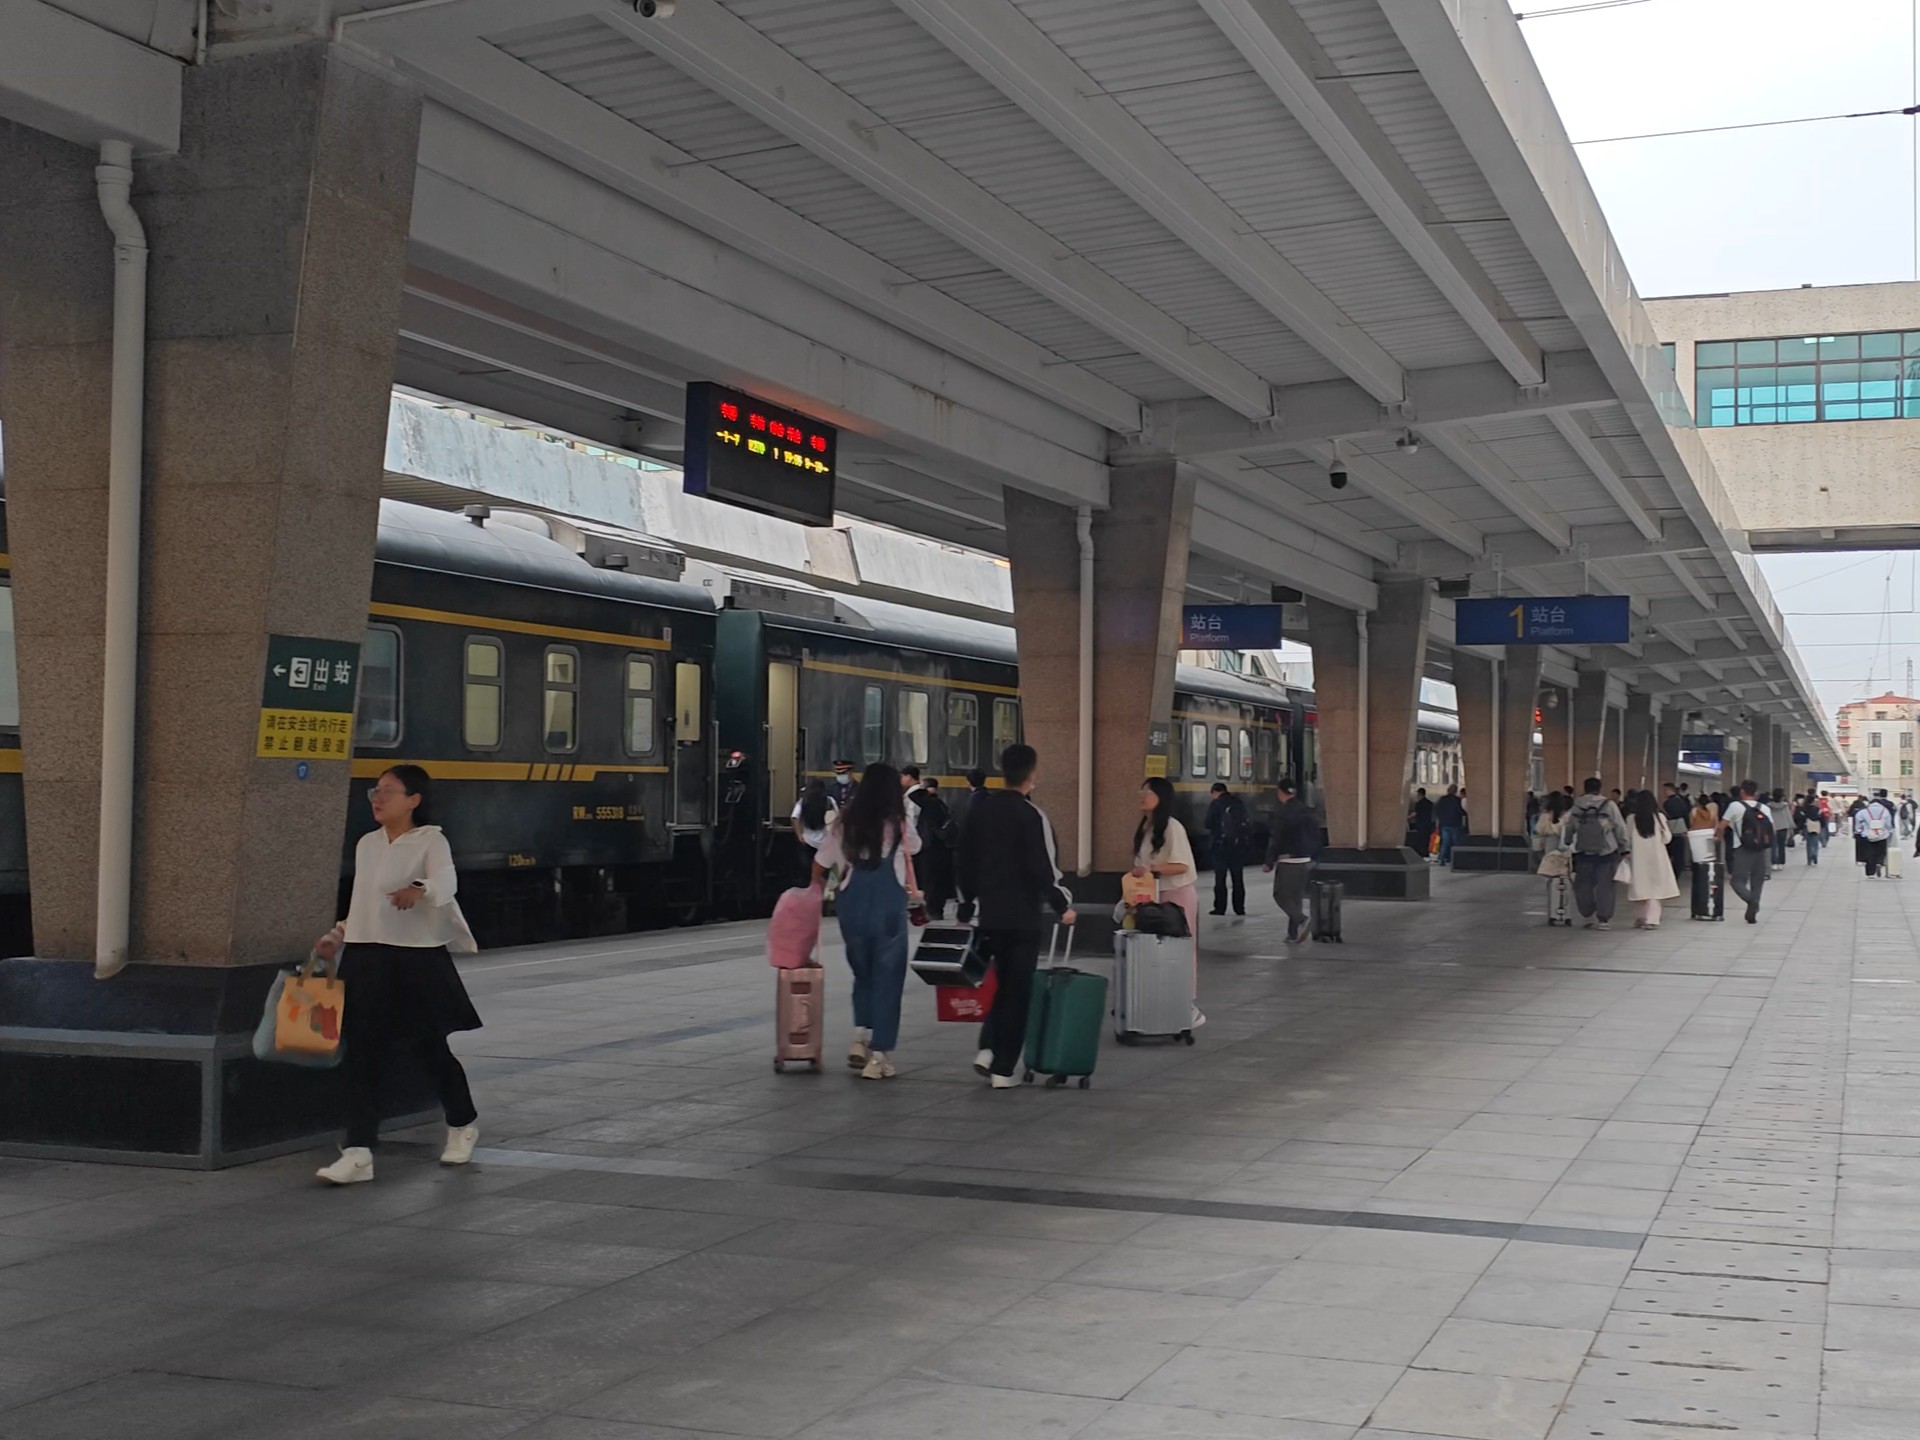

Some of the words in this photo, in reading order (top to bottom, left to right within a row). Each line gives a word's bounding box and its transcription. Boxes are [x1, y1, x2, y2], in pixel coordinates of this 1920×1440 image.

[1190, 613, 1224, 631] 站台
[1508, 604, 1524, 639] 1
[1530, 605, 1567, 624] 站台
[1189, 632, 1230, 643] Platform
[1530, 626, 1574, 637] Platform
[314, 659, 352, 685] 出站
[313, 683, 327, 692] Exit
